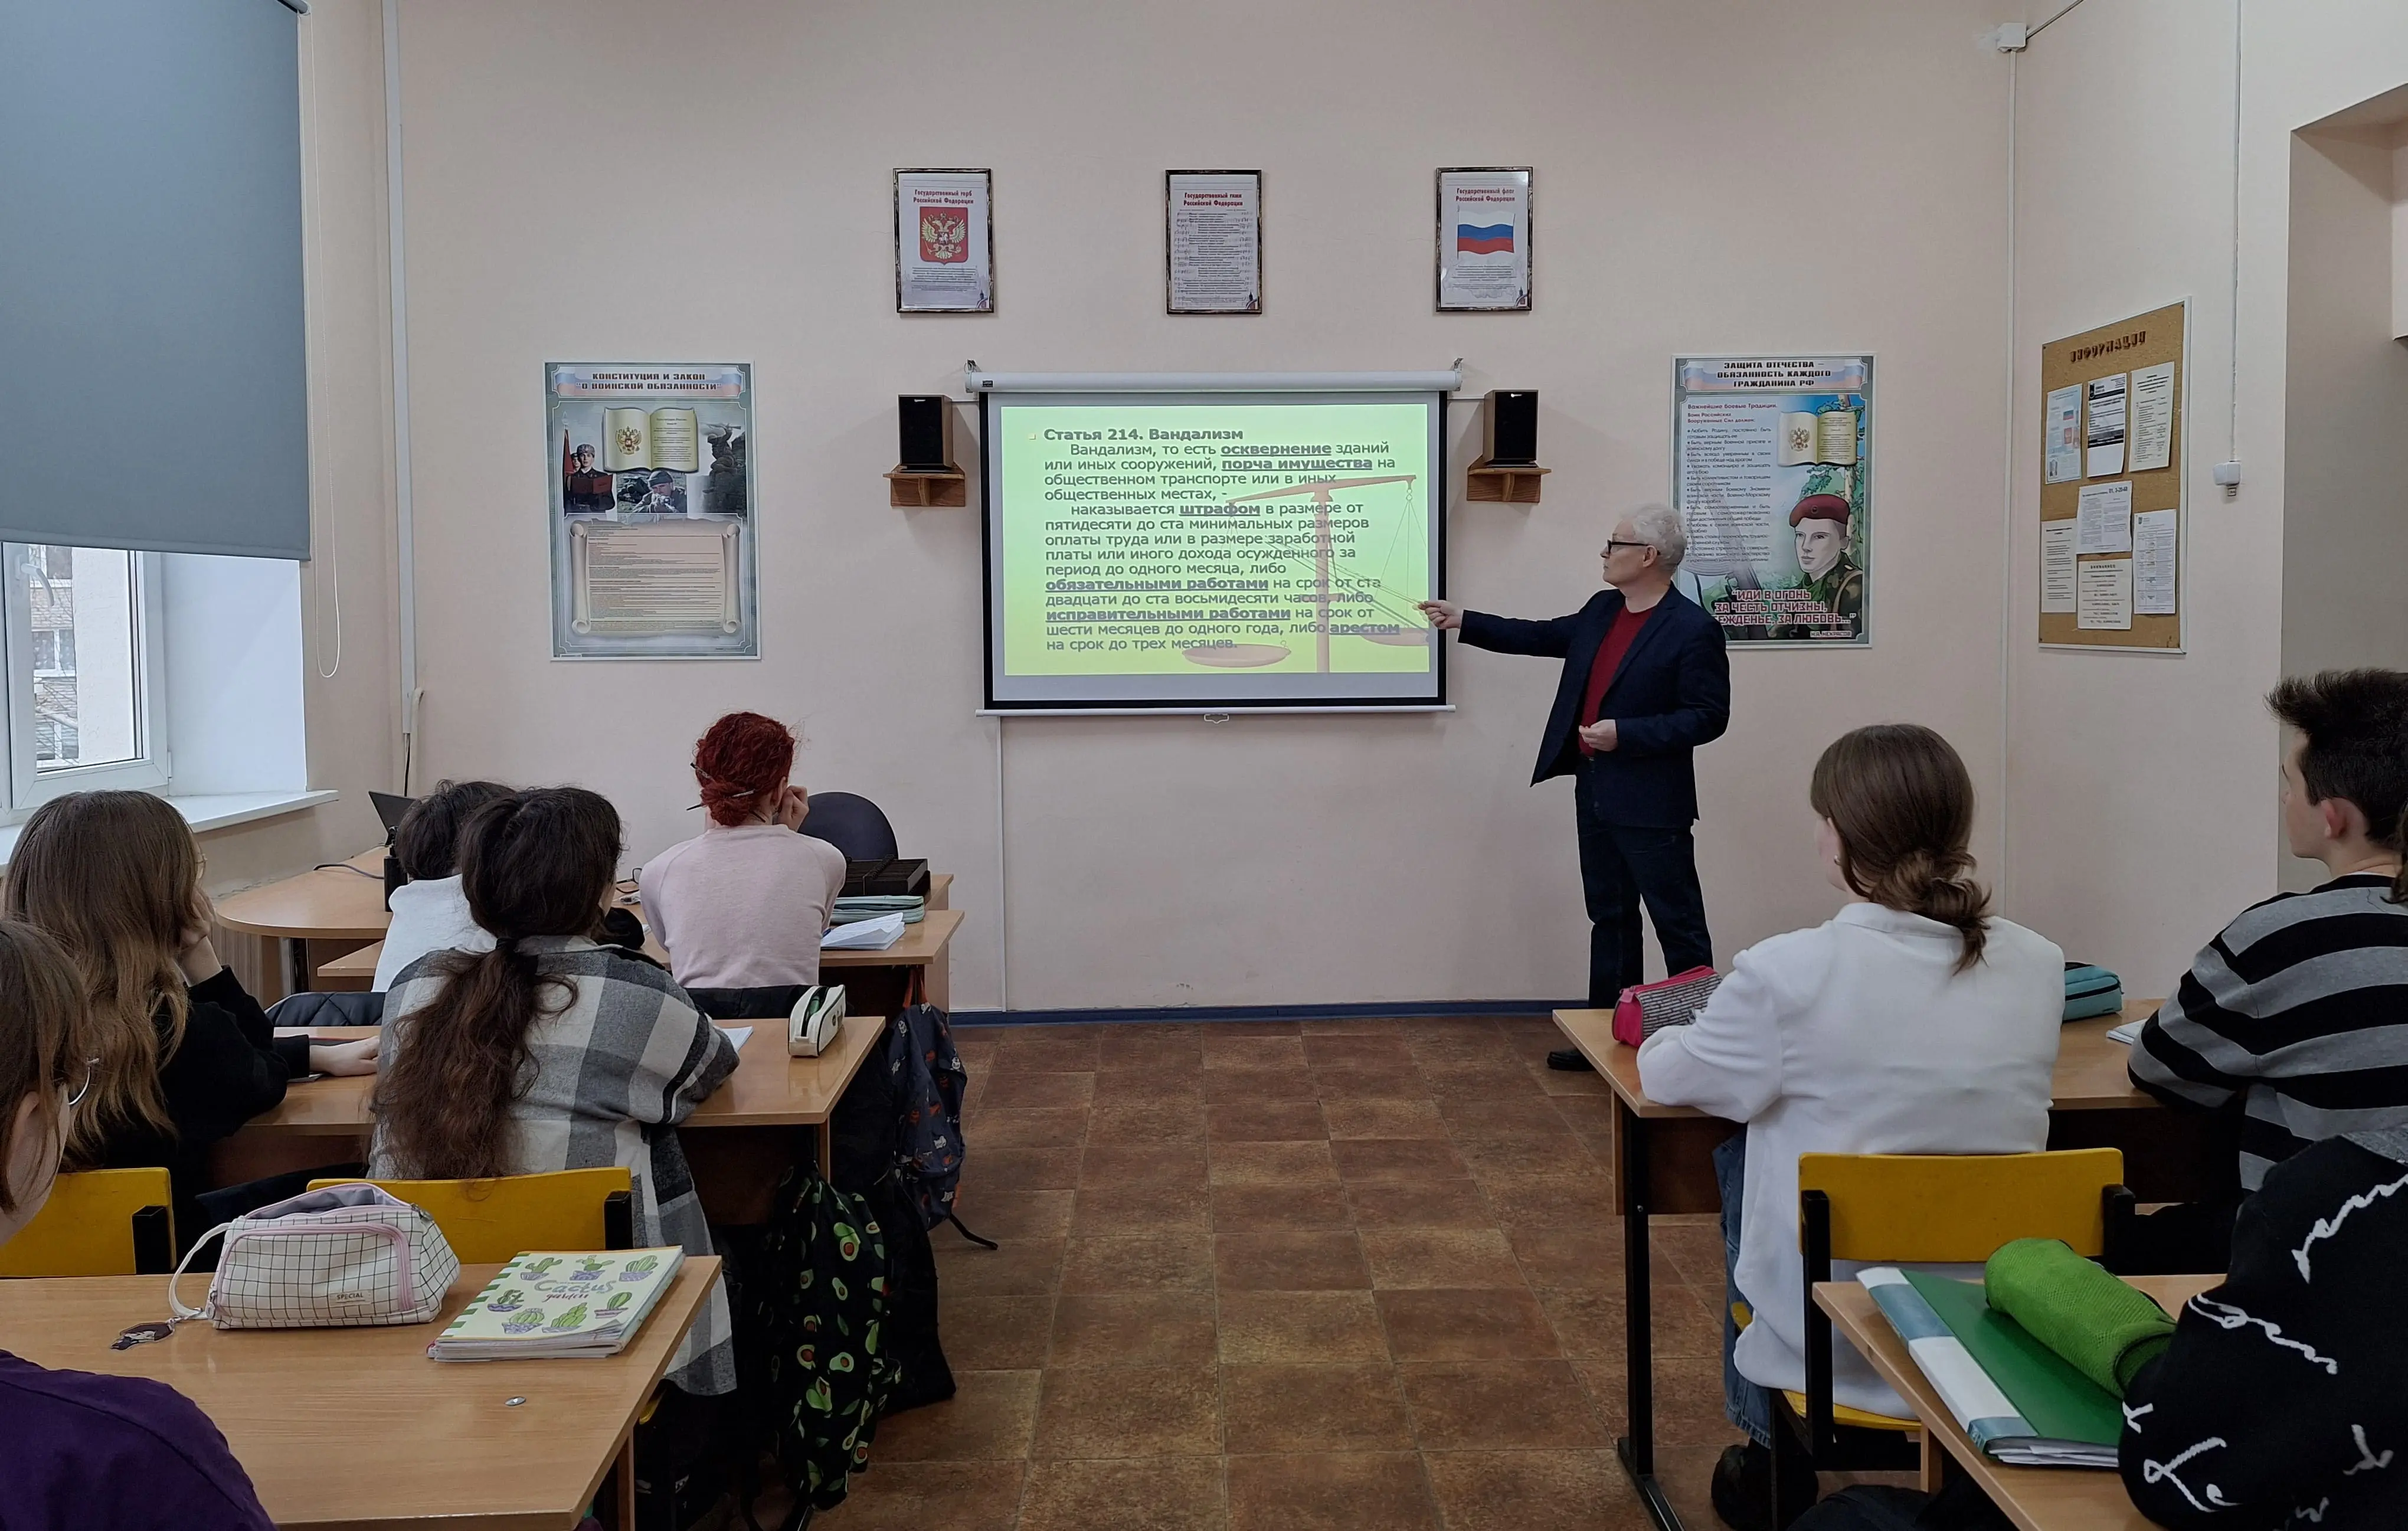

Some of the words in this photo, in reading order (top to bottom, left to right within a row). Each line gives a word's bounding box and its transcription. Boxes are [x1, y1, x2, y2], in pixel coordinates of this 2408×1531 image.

[1724, 362, 1762, 370] ЗАЩИТА
[1043, 428, 1102, 440] Статья
[1107, 428, 1143, 440] 214.
[1149, 428, 1243, 441] Вандализм
[1071, 444, 1157, 457] Вандализм,
[1162, 446, 1179, 455] то
[1184, 445, 1216, 454] есть
[1221, 444, 1332, 456] осквернение
[1336, 441, 1389, 454] зданий
[1045, 461, 1072, 470] или
[1078, 460, 1115, 470] иных
[1121, 457, 1216, 472] сооружений,
[1222, 460, 1272, 470] порча
[1278, 459, 1372, 470] имущества
[1378, 459, 1395, 467] на
[1045, 474, 1156, 486] общественном
[1160, 475, 1246, 487] транспорте
[1252, 475, 1279, 484] или
[1285, 475, 1293, 483] в
[1298, 474, 1336, 483] иных
[1045, 489, 1156, 501] общественных
[1162, 490, 1216, 501] местах,
[1071, 505, 1174, 515] наказывается
[1179, 504, 1261, 516] штрафом
[1266, 505, 1274, 513] в
[1280, 504, 1342, 516] размере
[1346, 504, 1364, 513] от
[1045, 521, 1131, 531] пятидесяти
[1137, 521, 1155, 531] до
[1160, 520, 1184, 529] ста
[1189, 519, 1293, 529] минимальных
[1298, 518, 1369, 531] размеров
[1045, 536, 1101, 546] оплаты
[1105, 535, 1149, 547] труда
[1154, 535, 1182, 544] или
[1187, 535, 1196, 544] в
[1201, 534, 1263, 546] размере
[1268, 531, 1355, 545] заработной
[1046, 550, 1092, 560] платы
[1098, 550, 1125, 560] или
[1130, 549, 1173, 559] иного
[1178, 549, 1231, 560] дохода
[1236, 549, 1335, 561] осужденного
[1339, 548, 1356, 558] за
[1046, 565, 1101, 577] период
[1105, 565, 1124, 575] до
[1129, 564, 1182, 575] одного
[1187, 564, 1244, 575] месяца,
[1249, 562, 1287, 574] либо
[1045, 578, 1182, 592] обязательными
[1186, 577, 1268, 591] работами
[1273, 580, 1291, 588] на
[1296, 579, 1330, 590] срок
[1335, 579, 1352, 588] от
[1357, 578, 1382, 588] ста
[1046, 596, 1117, 607] двадцати
[1122, 595, 1141, 605] до
[1146, 594, 1170, 604] ста
[1175, 594, 1279, 604] восьмидесяти
[1284, 594, 1331, 604] часов,
[1336, 591, 1374, 603] либо
[1764, 590, 1771, 600] В
[1775, 590, 1811, 600] ОГОНЬ
[1715, 603, 1730, 613] ЗА
[1732, 602, 1768, 613] ЧЕСТЬ
[1771, 602, 1827, 612] ОТЧИЗНЫ,
[1046, 610, 1204, 622] исправительными
[1209, 607, 1291, 620] работами
[1295, 609, 1313, 618] на
[1318, 609, 1352, 620] срок
[1357, 609, 1375, 618] от
[1712, 614, 1775, 626] ЕЖДЕНЬЕ,
[1778, 614, 1792, 624] ЗА
[1046, 626, 1092, 636] шести
[1098, 625, 1160, 636] месяцев
[1165, 624, 1183, 635] до
[1189, 624, 1241, 634] одного
[1246, 624, 1284, 635] года,
[1289, 621, 1326, 633] либо
[1329, 623, 1400, 634] арестом
[1047, 640, 1065, 650] на
[1070, 640, 1104, 652] срок
[1108, 639, 1127, 650] до
[1132, 639, 1166, 652] трех
[1172, 639, 1238, 650] месяцев.
[534, 1280, 617, 1294] Cactus
[336, 1292, 364, 1300] SPECIAL
